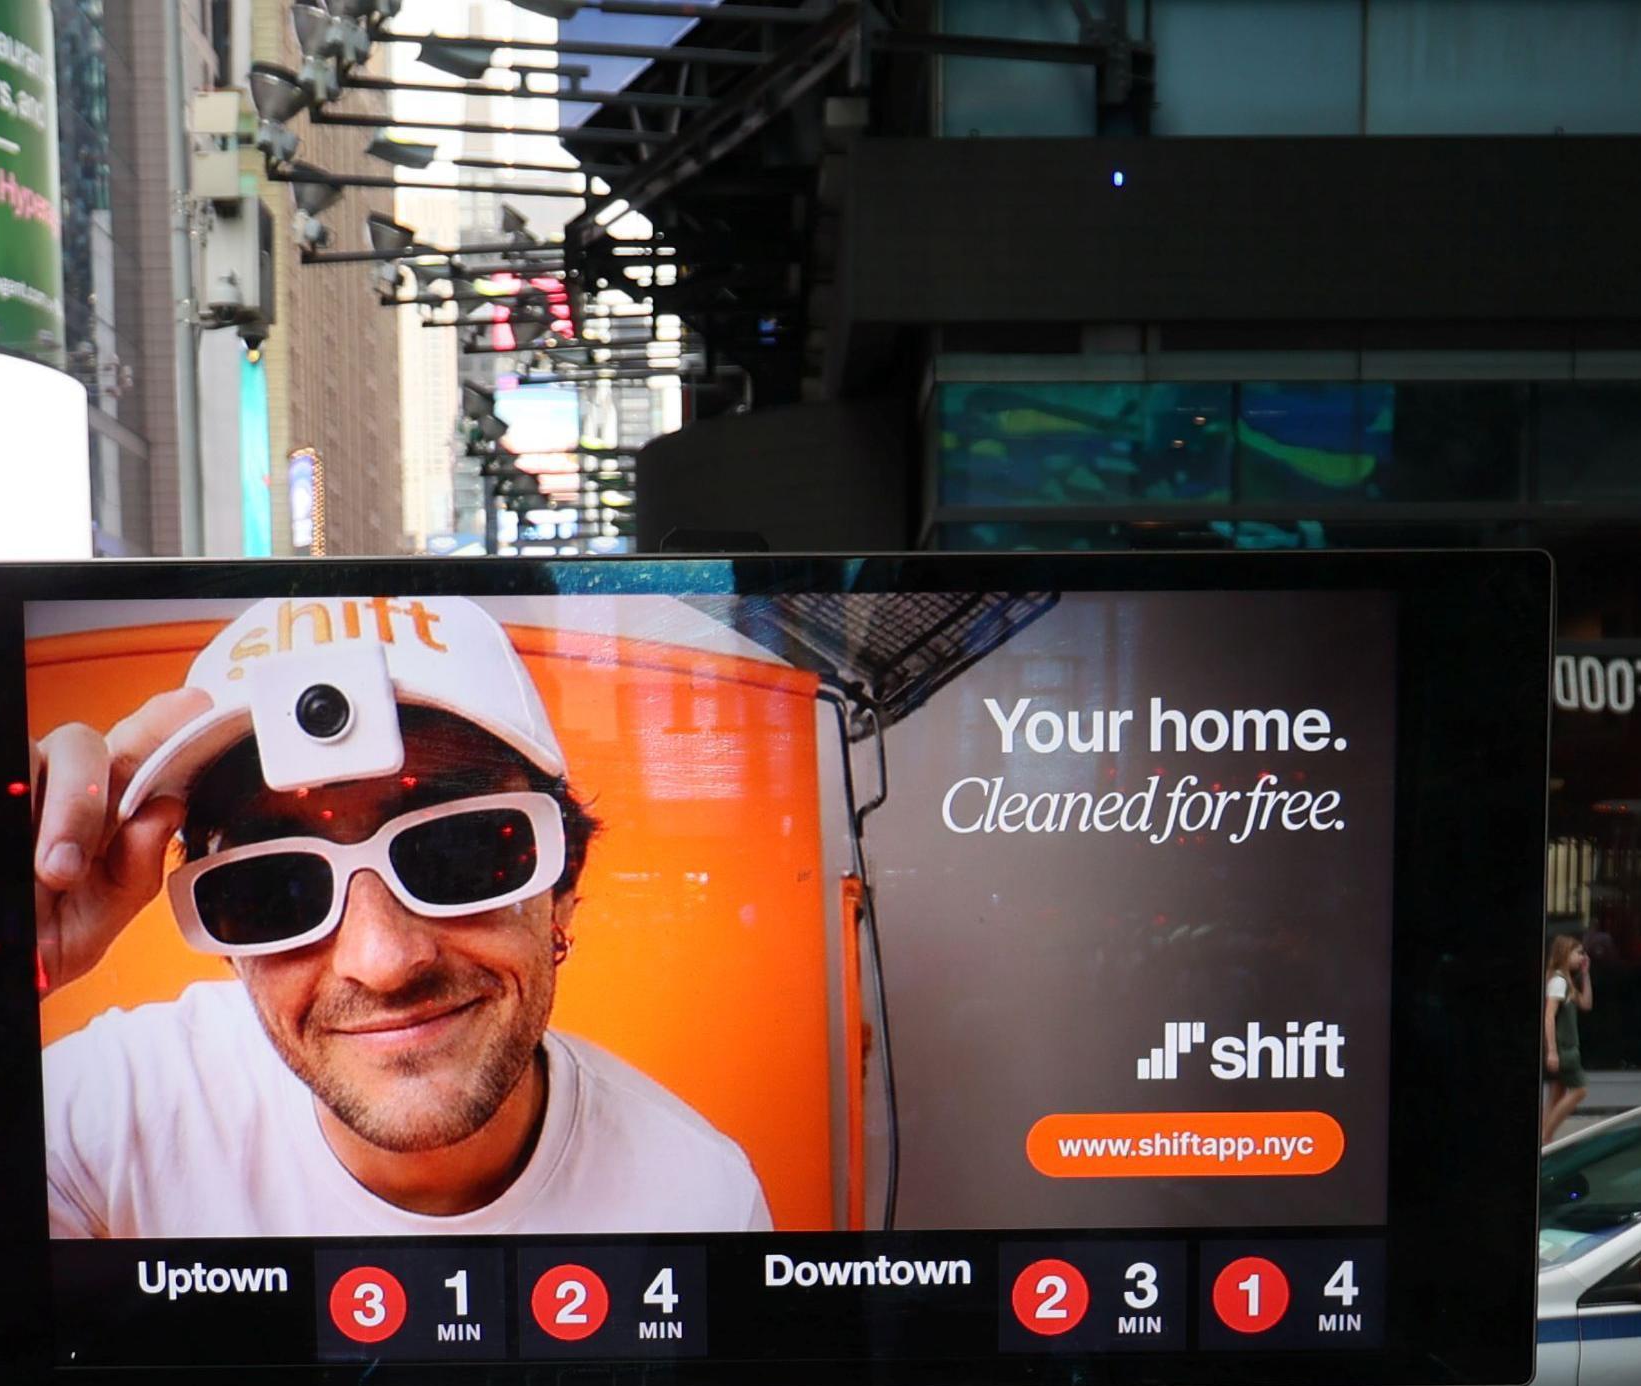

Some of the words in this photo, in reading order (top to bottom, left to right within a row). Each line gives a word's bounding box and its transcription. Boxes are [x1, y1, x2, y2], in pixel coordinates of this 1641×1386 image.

[984, 698, 1133, 753] Your
[1150, 697, 1346, 752] home.
[942, 774, 1160, 835] Cleaned
[1149, 774, 1240, 844] for
[1229, 774, 1346, 845] free.
[1211, 1022, 1344, 1079] shift
[1059, 1132, 1313, 1161] www.shiftapp.nyc
[139, 1261, 287, 1300] Uptown
[354, 1283, 385, 1326] 3
[445, 1270, 467, 1315] 1
[556, 1281, 586, 1323] 2
[644, 1268, 678, 1313] 4
[766, 1255, 970, 1286] Downtown
[1036, 1276, 1066, 1318] 2
[1124, 1263, 1158, 1308] 3
[1239, 1275, 1259, 1315] 1
[1324, 1261, 1358, 1305] 4
[438, 1324, 480, 1341] MIN
[640, 1322, 682, 1338] MIN
[1119, 1317, 1161, 1333] MIN
[1319, 1314, 1360, 1331] MIN
